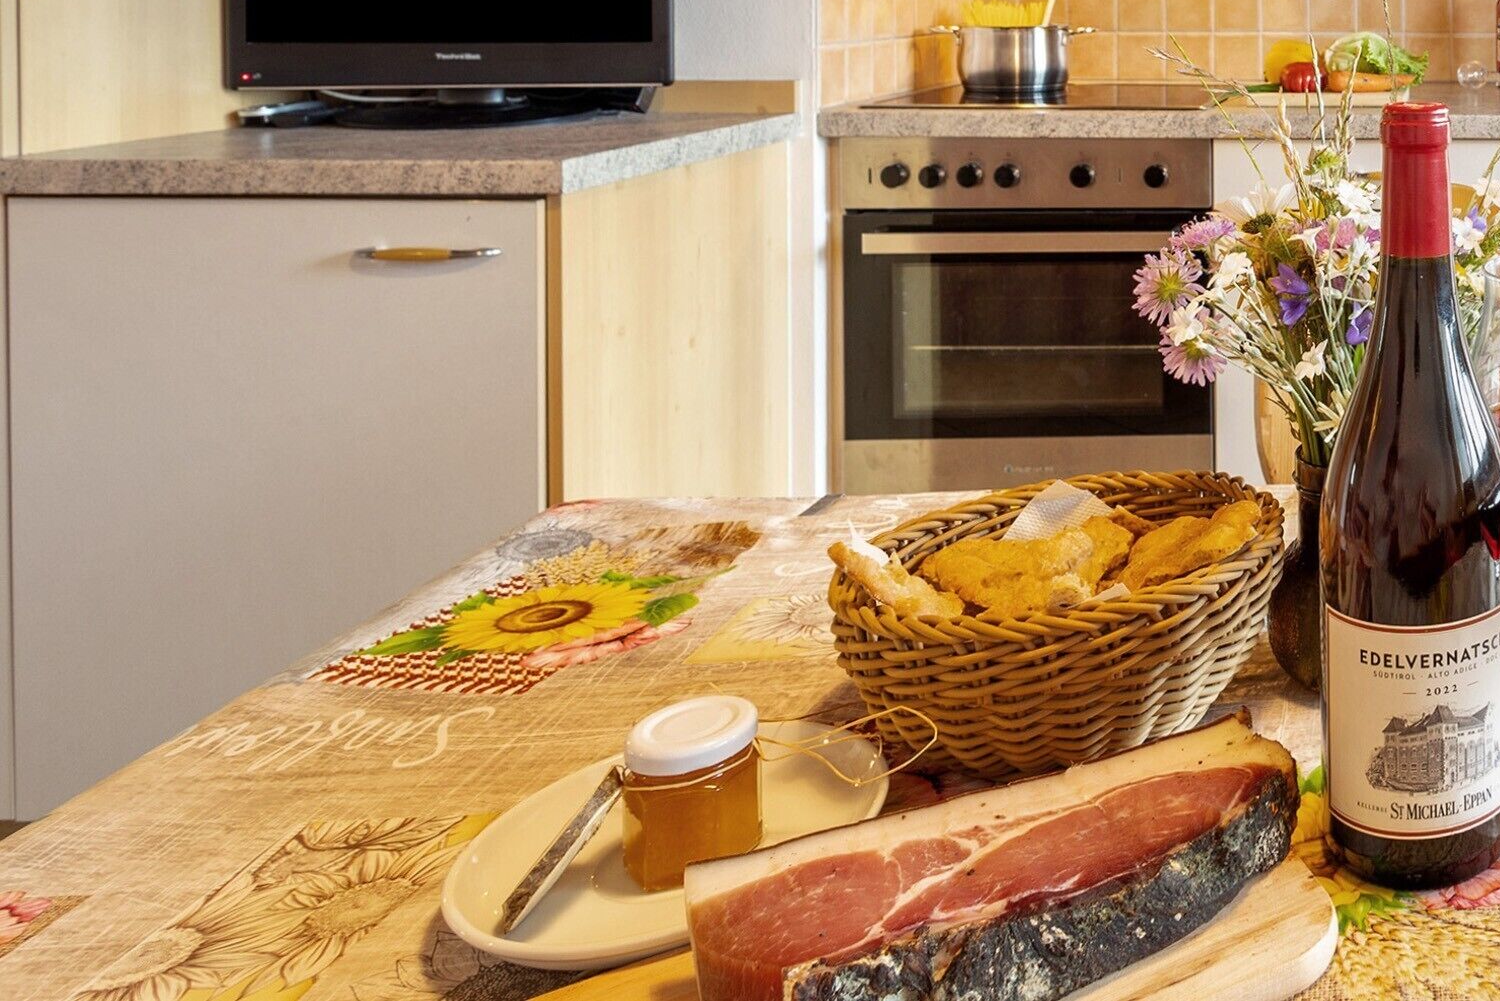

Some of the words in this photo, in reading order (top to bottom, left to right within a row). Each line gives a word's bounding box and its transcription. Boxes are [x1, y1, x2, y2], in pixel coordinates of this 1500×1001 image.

[1372, 670, 1416, 680] SÜDTIROL
[1428, 670, 1450, 679] ALTO
[1453, 662, 1478, 675] ADIGE
[1425, 684, 1458, 696] 2022
